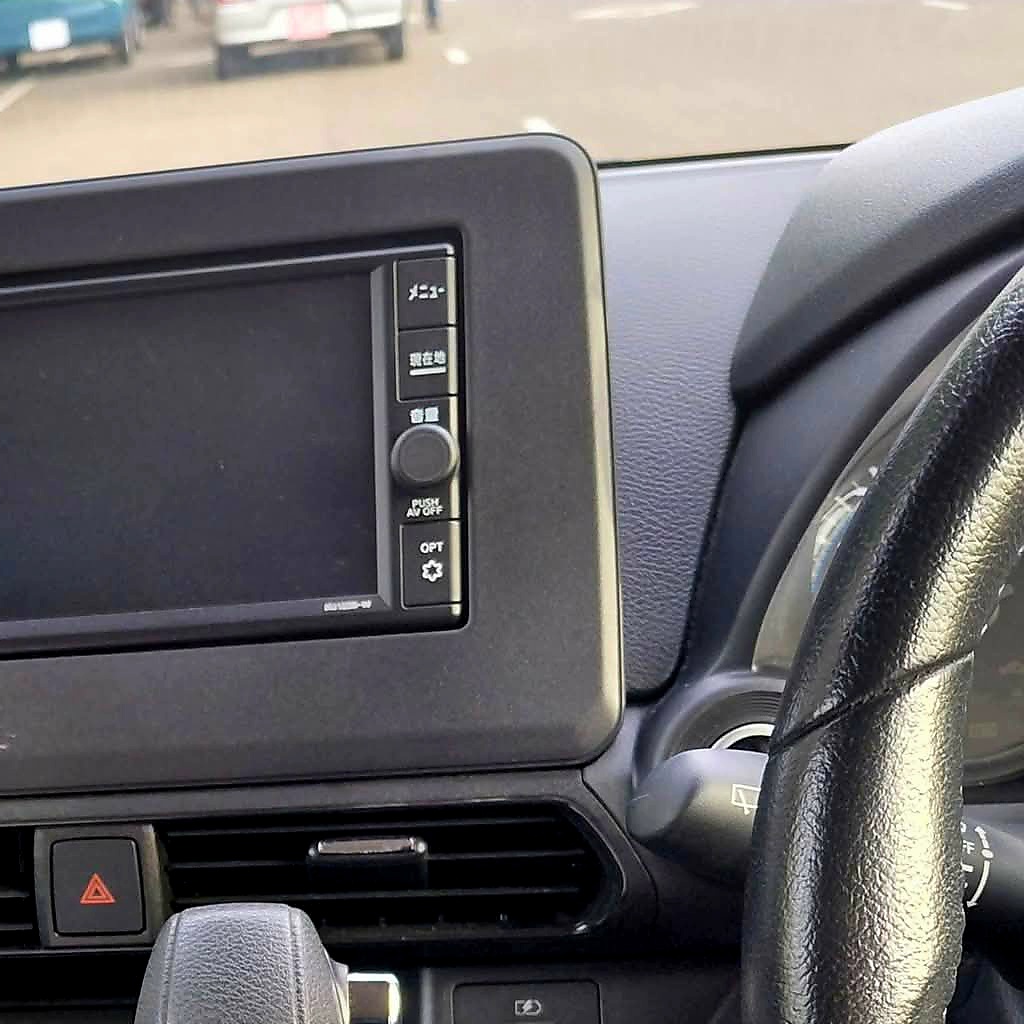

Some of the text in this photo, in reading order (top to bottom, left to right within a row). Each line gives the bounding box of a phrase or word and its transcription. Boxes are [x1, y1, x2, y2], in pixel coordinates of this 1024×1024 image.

[408, 283, 446, 301] メニュー
[409, 350, 447, 367] 現在地
[411, 498, 439, 509] PUSH
[406, 505, 443, 518] AV OFF
[419, 541, 444, 554] OPT
